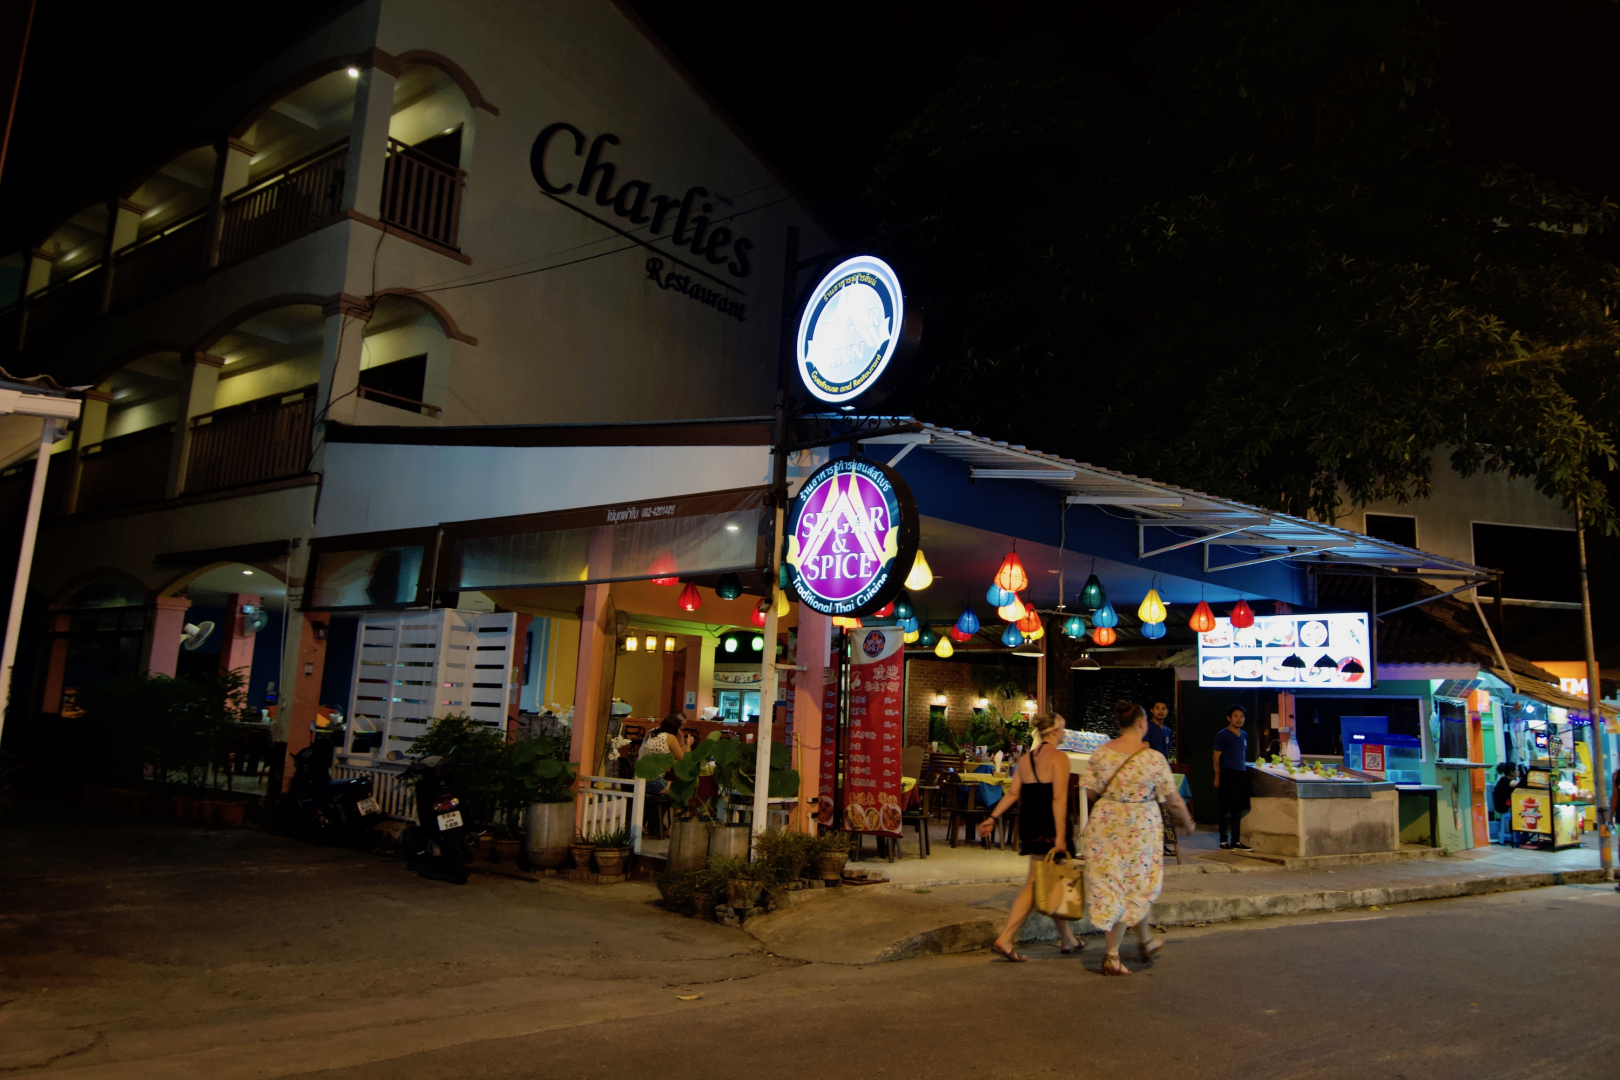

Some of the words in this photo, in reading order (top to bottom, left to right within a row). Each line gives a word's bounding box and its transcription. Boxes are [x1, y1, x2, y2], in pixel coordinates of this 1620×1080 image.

[530, 122, 753, 278] Charlies
[645, 257, 746, 322] Restaurant
[811, 370, 838, 393] Guesthouse
[840, 382, 852, 392] and
[853, 354, 882, 387] Restaurant
[801, 506, 885, 538] SUGAR
[831, 533, 851, 553] &
[806, 552, 873, 581] SPICE
[792, 574, 833, 614] Traditional
[834, 600, 855, 614] Thai
[856, 573, 888, 607] Cuisine
[873, 664, 900, 680] 欢迎
[1549, 678, 1589, 696] TM
